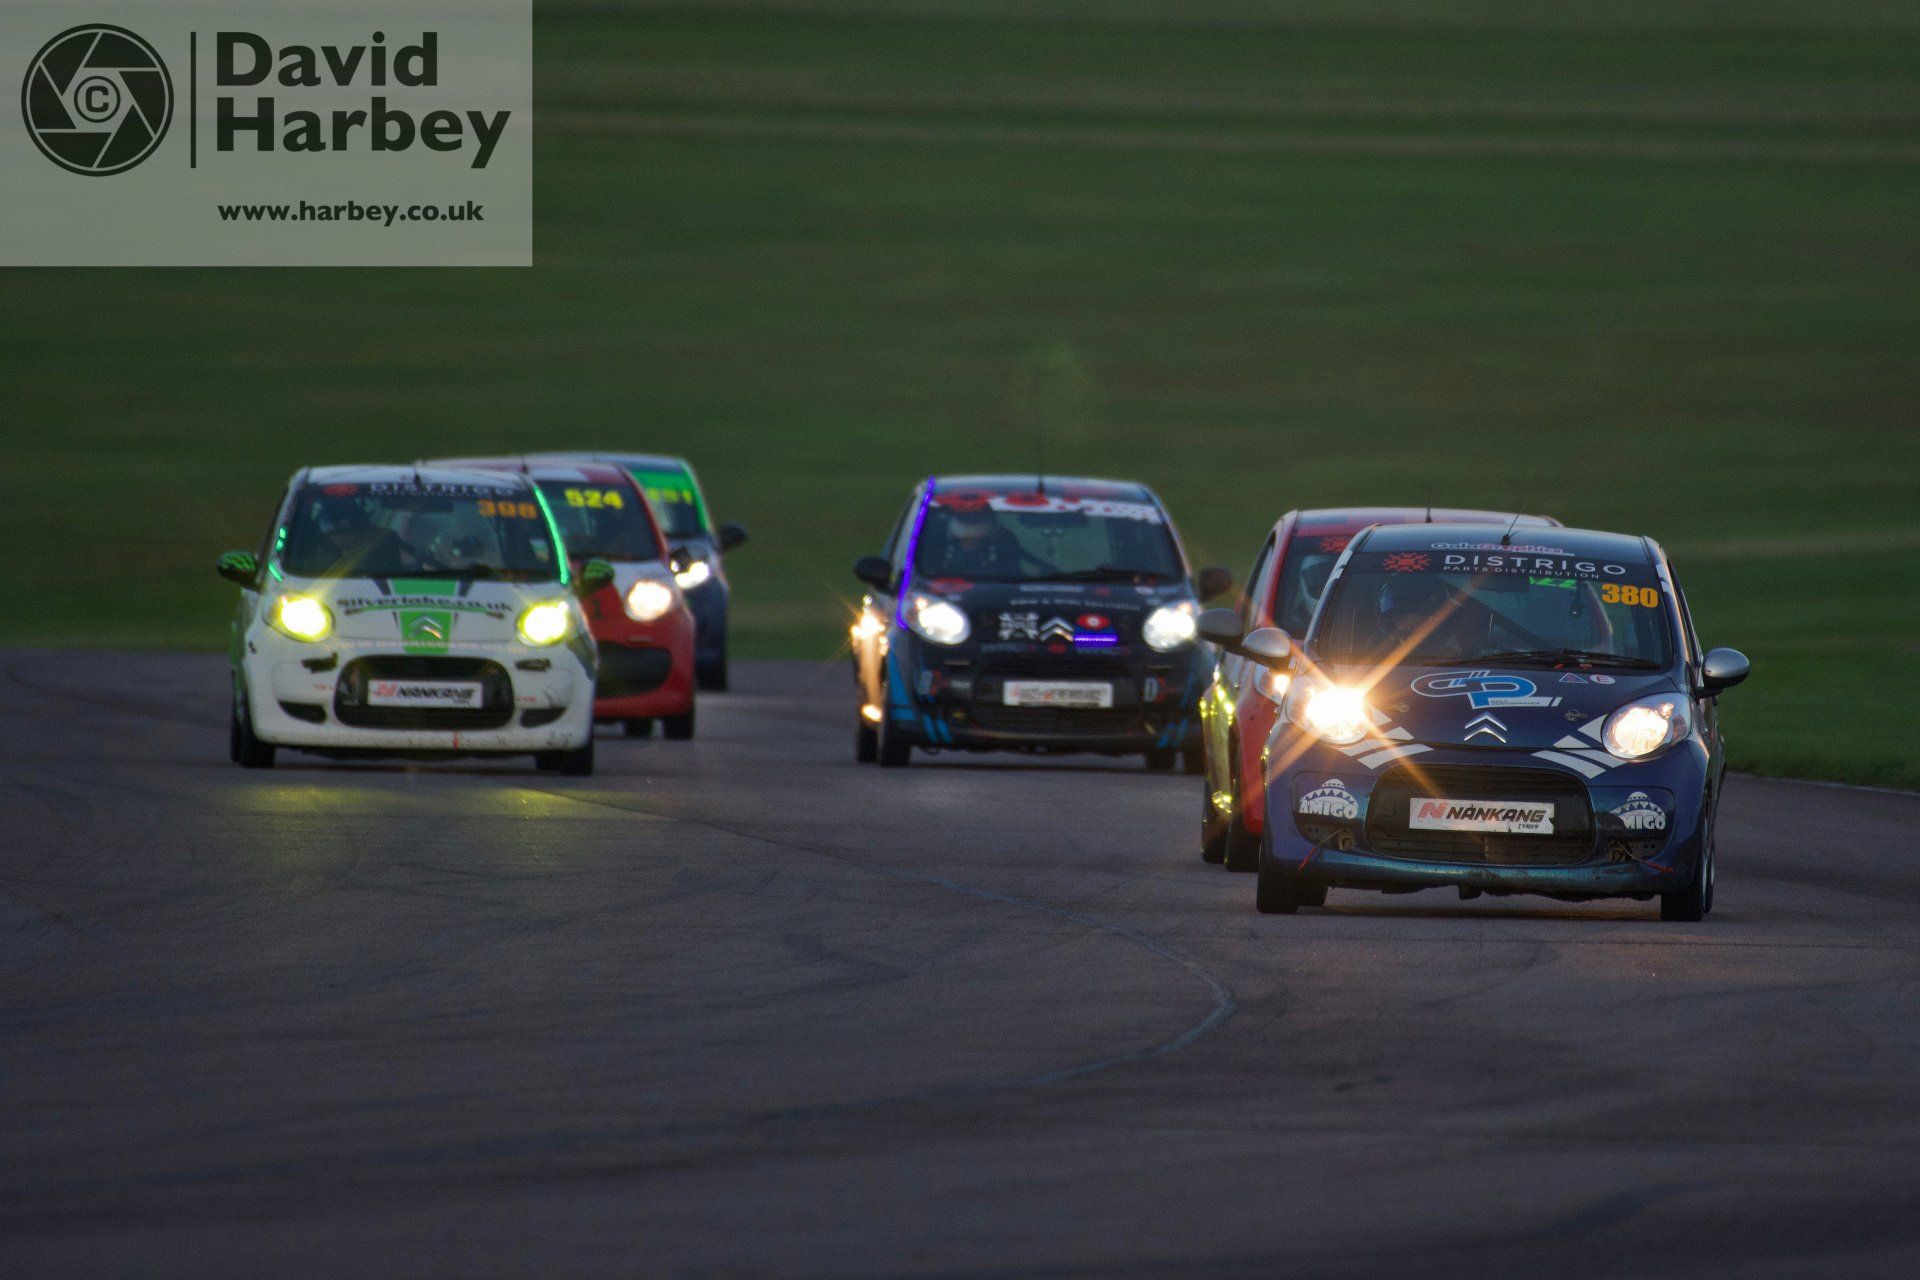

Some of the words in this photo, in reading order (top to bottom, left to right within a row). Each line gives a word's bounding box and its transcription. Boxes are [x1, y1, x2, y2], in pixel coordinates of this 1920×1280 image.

[1443, 565, 1489, 573] PARTS
[1494, 567, 1600, 580] DISTRIBUTION
[1444, 554, 1627, 576] DISTRIGO
[1601, 582, 1659, 608] 380
[1299, 800, 1358, 820] AMIGO
[1446, 806, 1547, 823] NANKANG
[1620, 814, 1667, 831] MIGO
